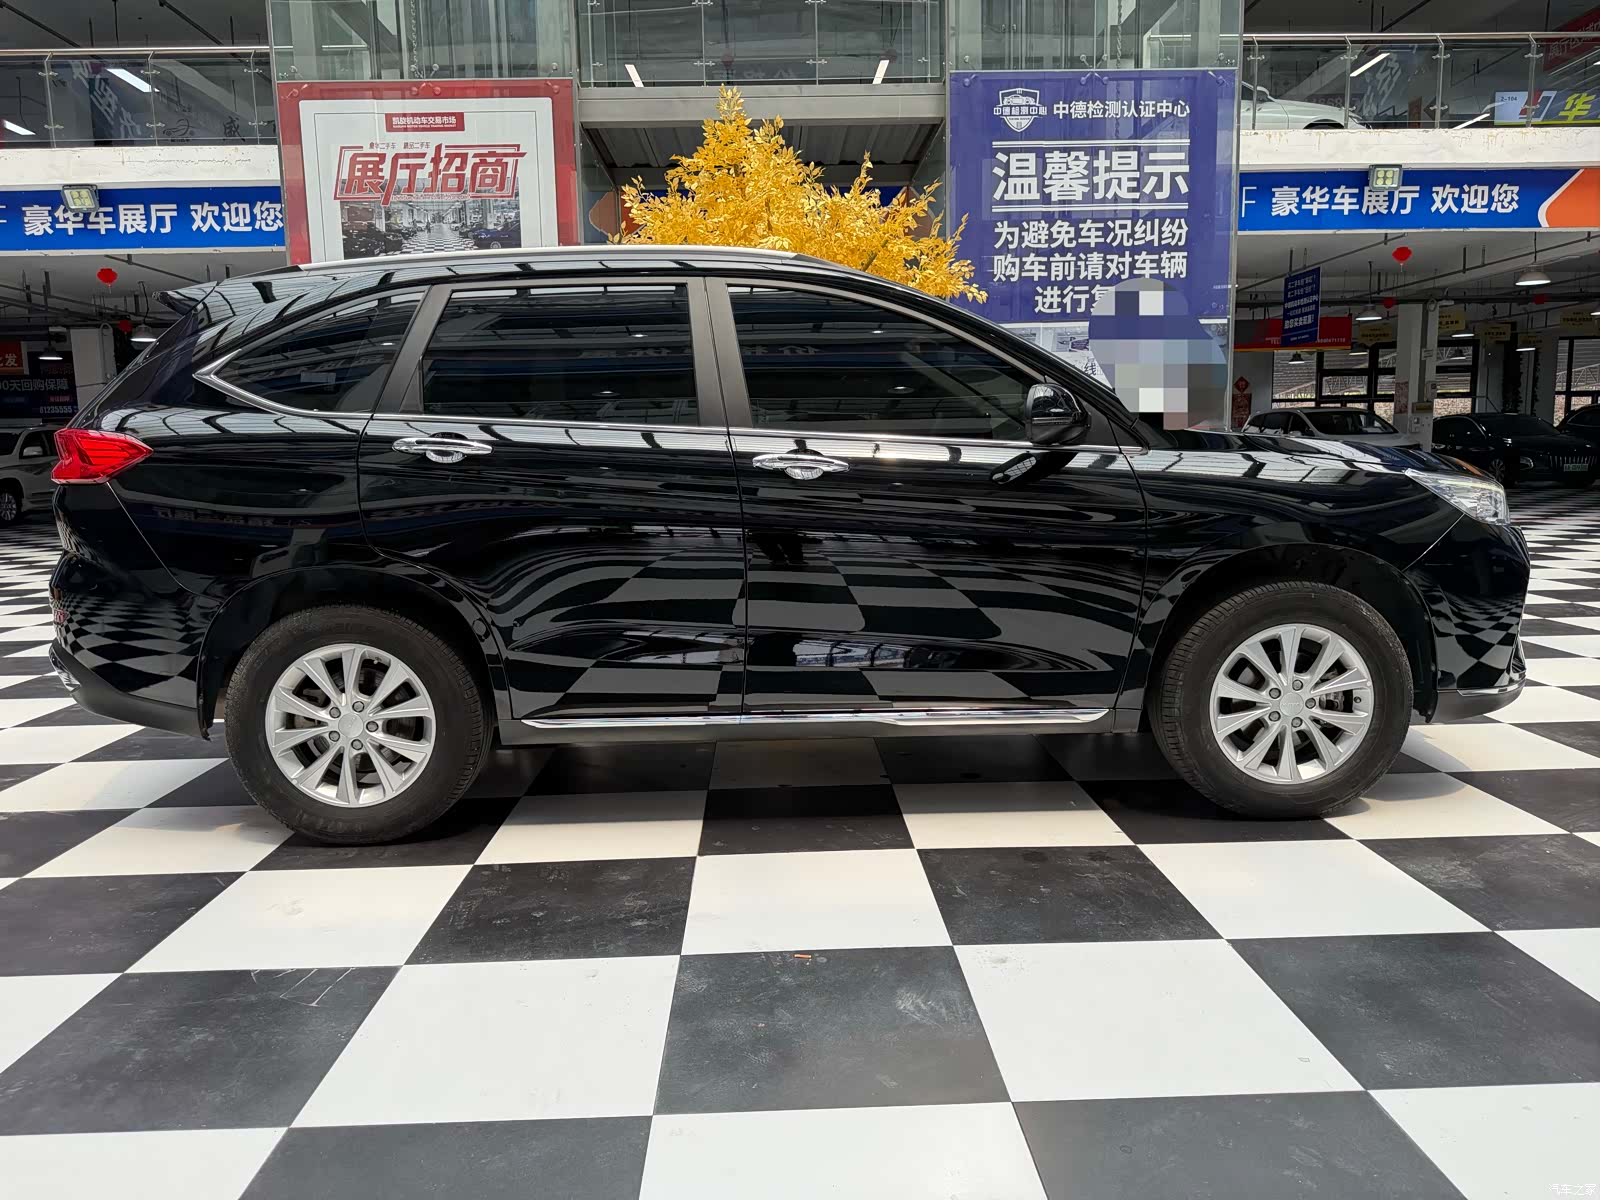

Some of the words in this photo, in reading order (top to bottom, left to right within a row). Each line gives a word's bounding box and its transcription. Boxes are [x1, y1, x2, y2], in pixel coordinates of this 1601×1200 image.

[392, 116, 457, 125] 凯旋机动车交易市场
[1053, 99, 1191, 119] 中德检测认证中心
[1558, 93, 1597, 122] 华
[343, 143, 528, 206] 展厅招商
[992, 149, 1190, 201] 温馨提示
[1270, 185, 1420, 217] 豪华车展厅
[1430, 183, 1520, 215] 欢迎您
[22, 202, 178, 236] 豪华车展厅
[190, 200, 284, 233] 欢迎您
[994, 218, 1189, 249] 为避免车况纠纷
[993, 250, 1188, 282] 购车前请对车辆
[0, 378, 70, 391] 0天回购保障
